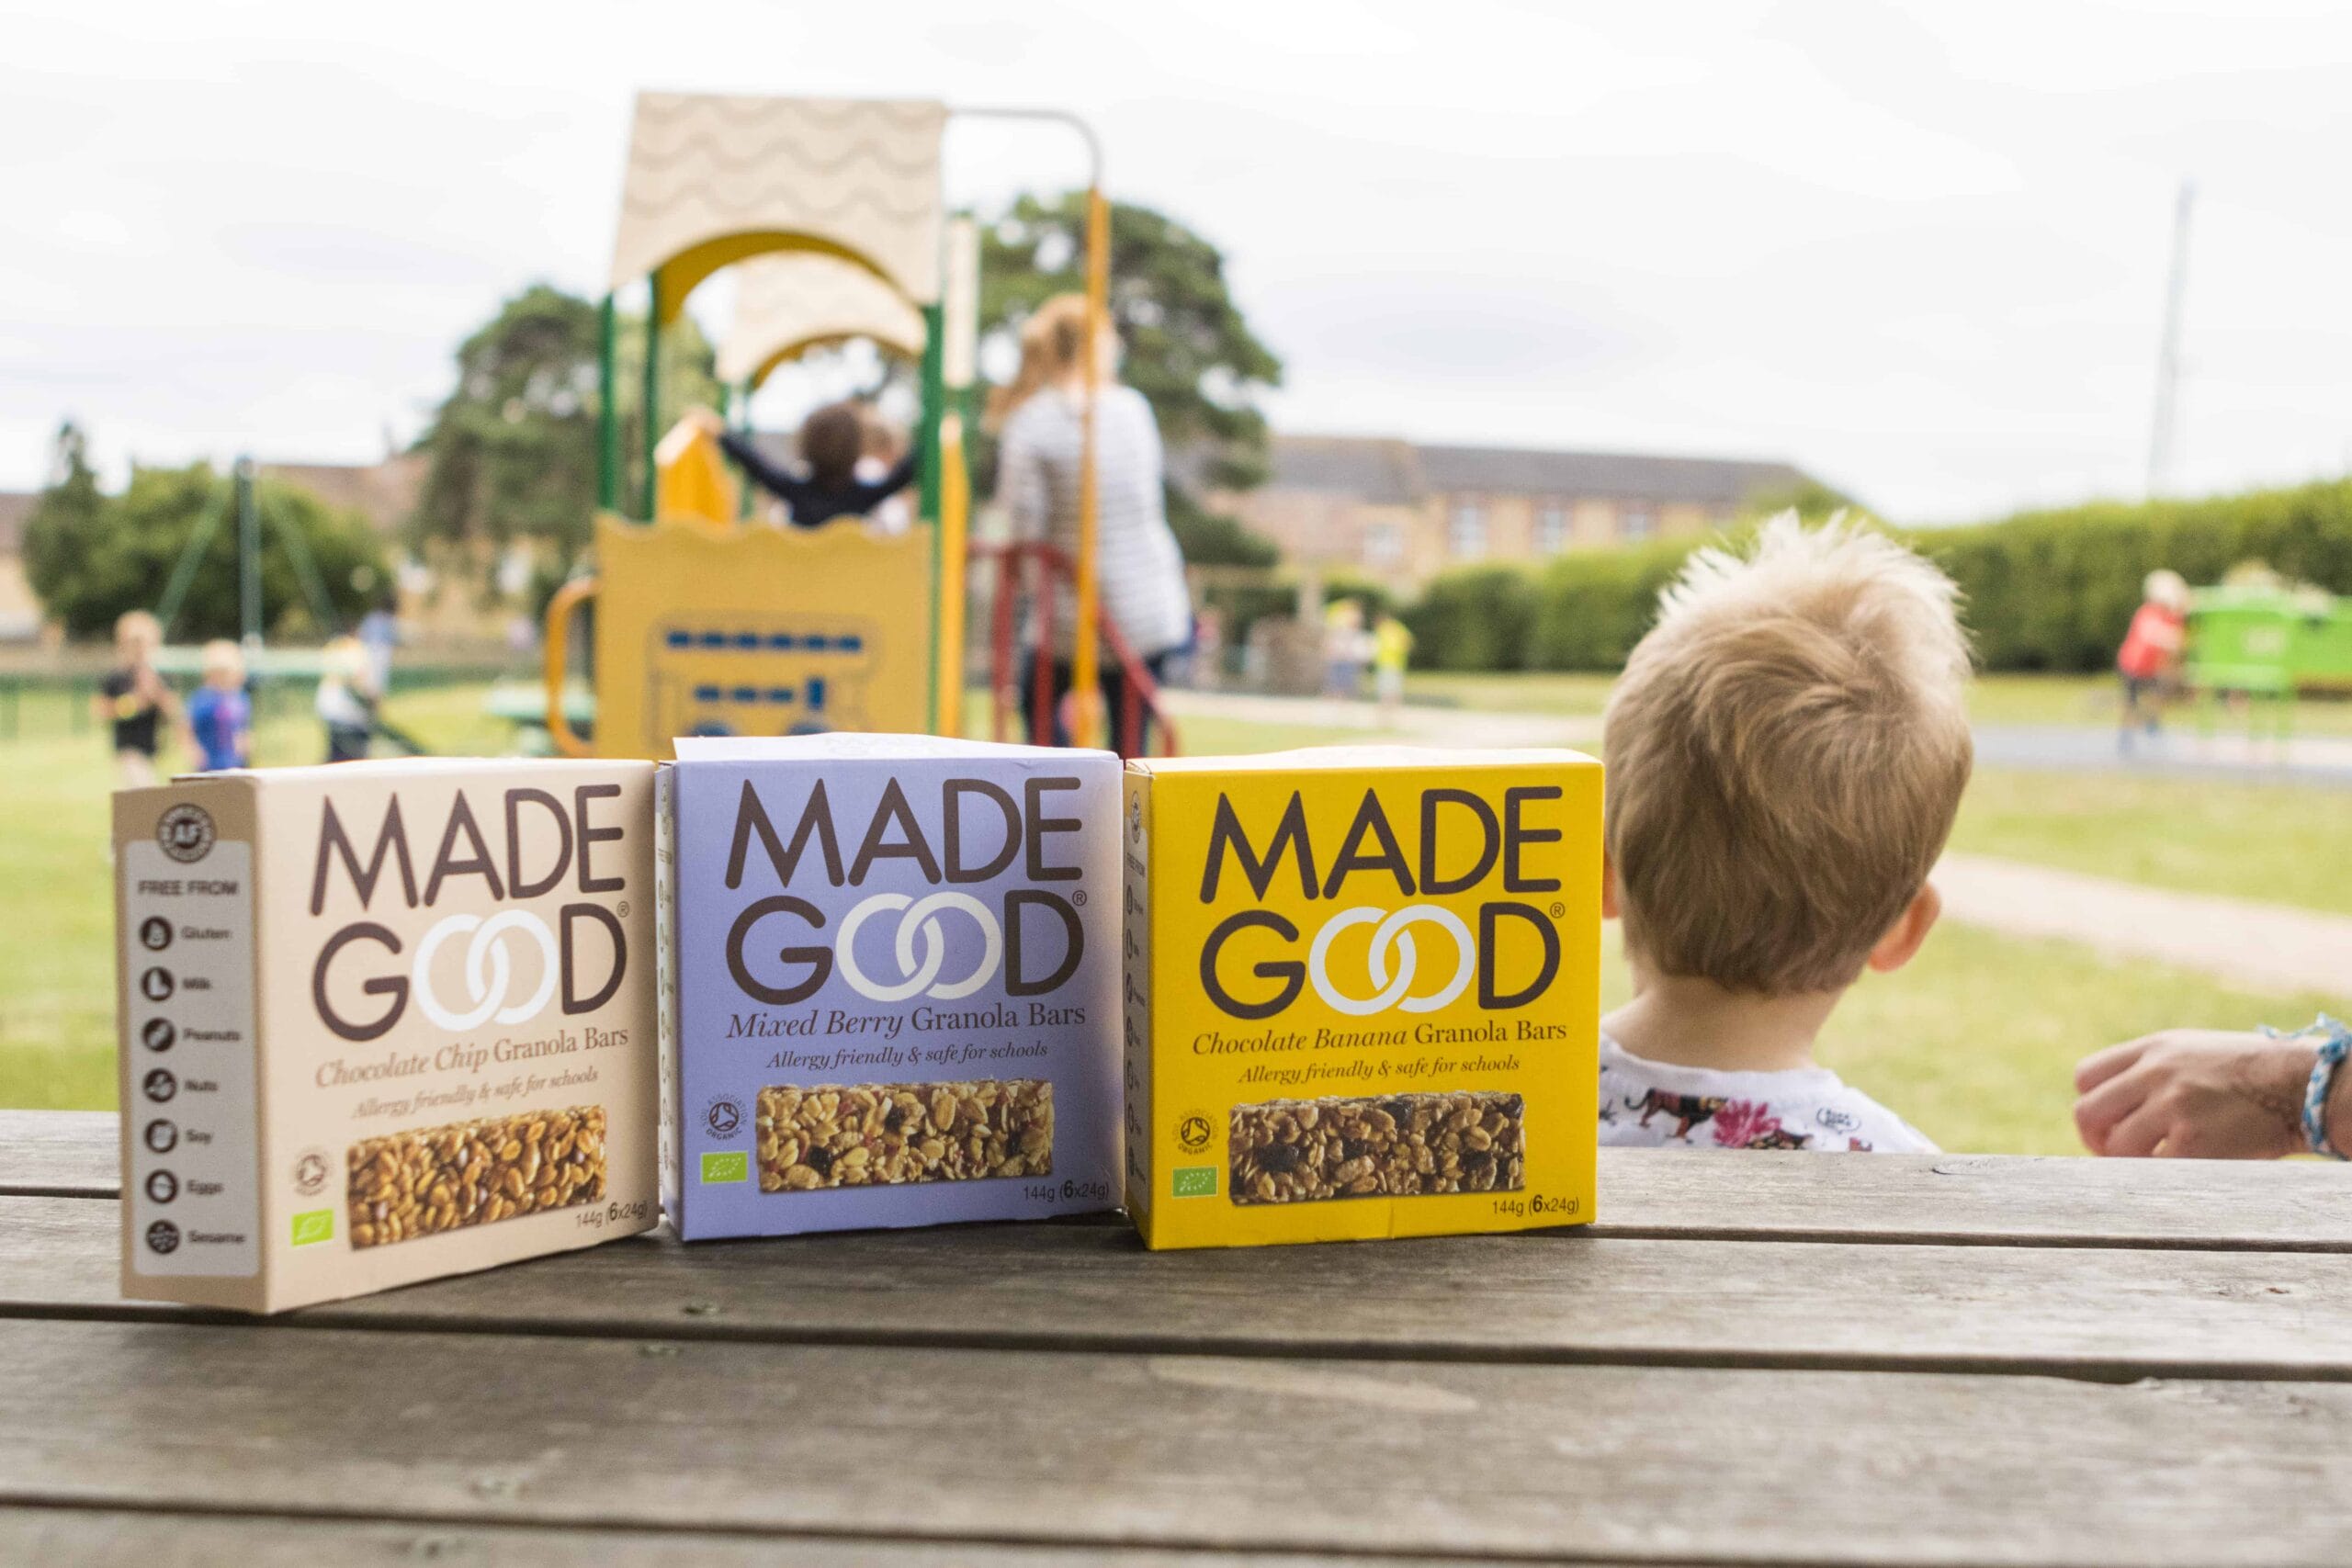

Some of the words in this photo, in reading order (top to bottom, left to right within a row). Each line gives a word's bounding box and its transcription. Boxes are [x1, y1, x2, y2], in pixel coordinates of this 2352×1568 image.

[311, 784, 626, 916] MADE
[725, 777, 1082, 890] MADE
[1200, 786, 1563, 904] MADE
[139, 880, 183, 896] FREE
[187, 880, 239, 896] FROM
[726, 889, 1084, 1006] GOOD
[1199, 902, 1560, 1021] GOOD
[312, 902, 628, 1043] GOOD
[725, 1010, 819, 1039] Mixed
[827, 1009, 904, 1040] Berry
[911, 1002, 1020, 1032] Granola
[1028, 1002, 1087, 1027] Bars
[1192, 1030, 1307, 1055] Chocolate
[1314, 1027, 1408, 1050] Banana
[1414, 1020, 1508, 1044] Granola
[1517, 1020, 1567, 1041] Bars
[314, 1052, 430, 1088] Chocolate
[434, 1040, 491, 1075] Chip
[493, 1029, 579, 1064] Granola
[584, 1025, 630, 1051] Bars
[764, 1049, 829, 1069] Allergy
[826, 1046, 906, 1069] friendly
[907, 1048, 922, 1066] &
[925, 1043, 959, 1064] safe
[956, 1042, 987, 1064] for
[989, 1040, 1049, 1059] schools
[1238, 1064, 1302, 1085] Allergy
[1300, 1060, 1375, 1084] friendly
[1377, 1062, 1393, 1079] &
[1396, 1057, 1430, 1078] safe
[1428, 1056, 1459, 1078] for
[1462, 1054, 1521, 1074] schools
[492, 1077, 524, 1100] safe
[524, 1072, 548, 1097] for
[548, 1065, 599, 1089] schools
[706, 1126, 742, 1141] ORGANIC
[1023, 1184, 1056, 1203] 144g
[1058, 1179, 1110, 1202] (6x24g)
[1492, 1199, 1524, 1218] 144g
[1527, 1193, 1579, 1217] (6x24g)
[575, 1211, 604, 1229] 144g
[605, 1201, 648, 1227] (6x24g)
